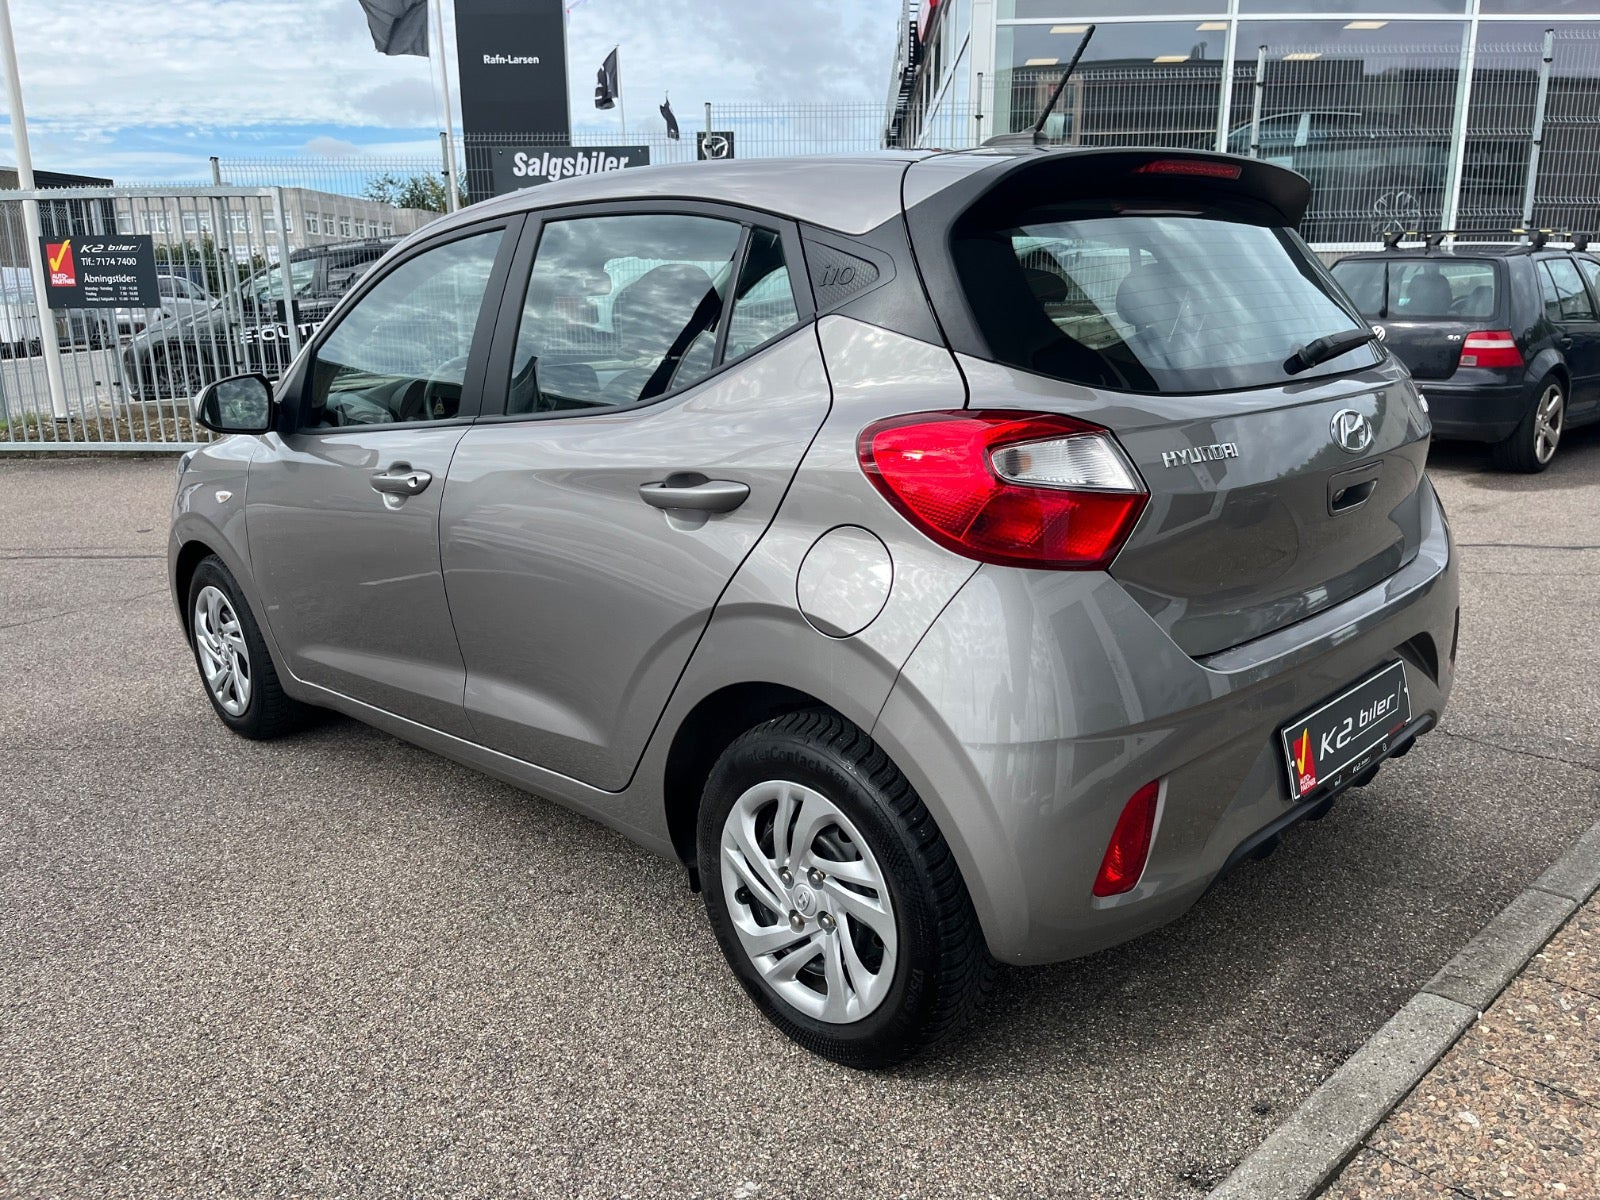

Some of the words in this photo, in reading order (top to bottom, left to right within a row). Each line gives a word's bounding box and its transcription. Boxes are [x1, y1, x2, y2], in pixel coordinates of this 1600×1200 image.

[483, 54, 540, 64] Rafn-Larsen
[512, 152, 629, 181] Salgsbiler
[80, 244, 105, 253] K2
[107, 244, 137, 252] biler
[81, 258, 95, 266] Tlf.:
[84, 273, 137, 284] Åbningstider:
[820, 264, 856, 287] i10
[1161, 442, 1239, 468] HYUNDAI
[1319, 716, 1353, 762] K2
[1359, 693, 1395, 727] biler
